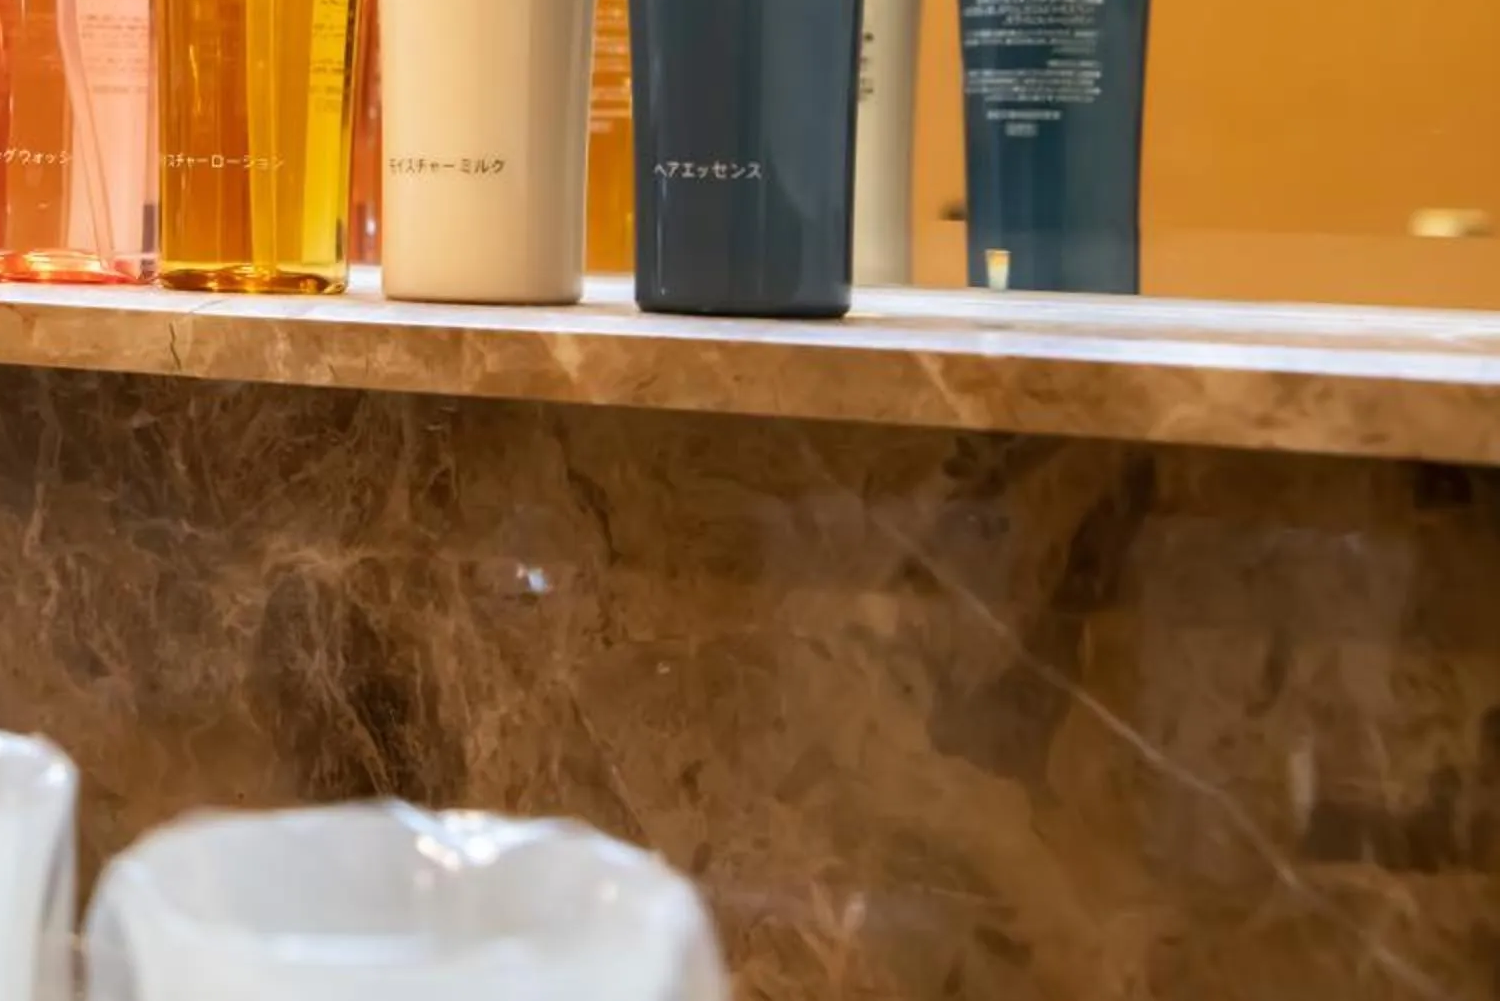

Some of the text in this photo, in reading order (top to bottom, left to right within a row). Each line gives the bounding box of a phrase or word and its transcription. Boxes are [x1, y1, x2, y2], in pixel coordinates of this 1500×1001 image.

[654, 160, 762, 179] ヘアエッセンス
